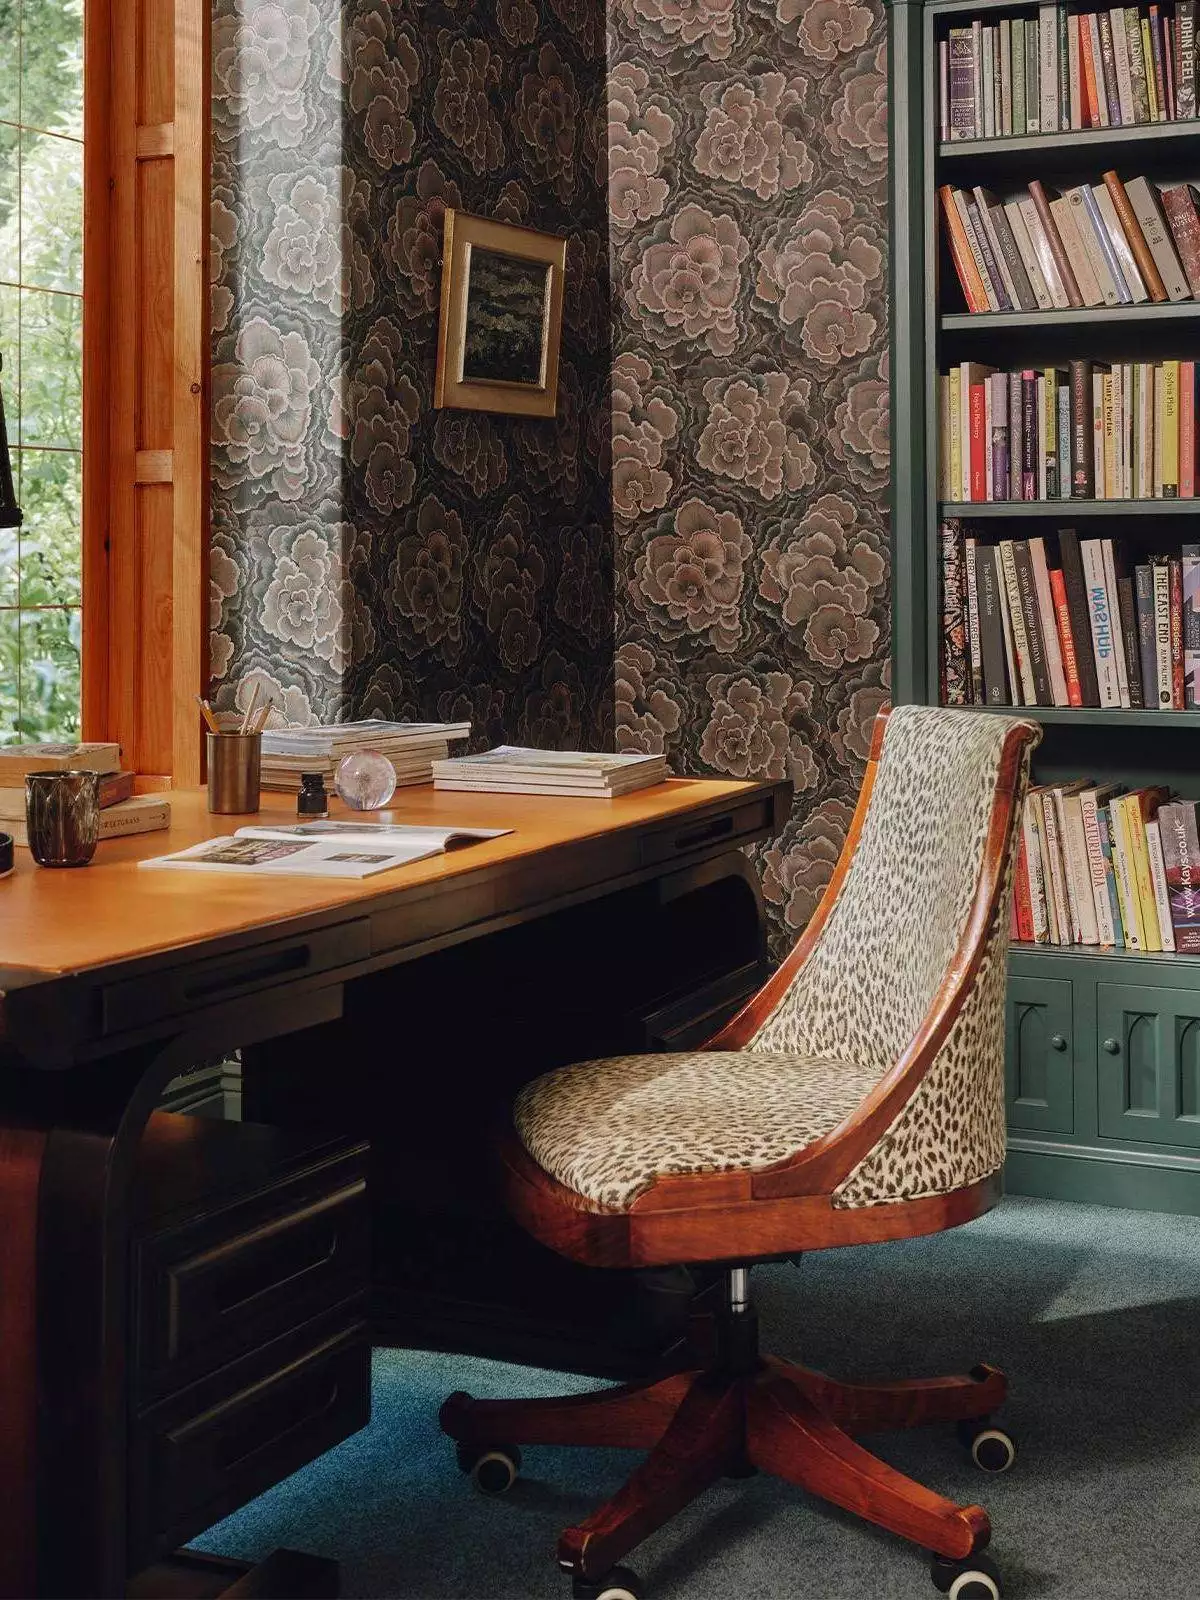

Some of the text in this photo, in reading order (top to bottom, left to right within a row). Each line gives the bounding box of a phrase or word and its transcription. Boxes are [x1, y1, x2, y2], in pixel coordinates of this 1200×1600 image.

[1129, 26, 1141, 76] WILDING
[1181, 16, 1194, 83] JOHN PEEL
[1165, 371, 1174, 394] Sylvia
[1156, 571, 1167, 591] THE
[967, 547, 979, 663] KERRY JAMES MARSHALL
[1012, 605, 1026, 648] FOWLER
[1157, 593, 1169, 622] EAST
[1060, 603, 1071, 638] WORKING
[1066, 648, 1078, 682] RESTORE
[1158, 623, 1169, 644] END
[1083, 801, 1105, 887] CREATUREPEDIA
